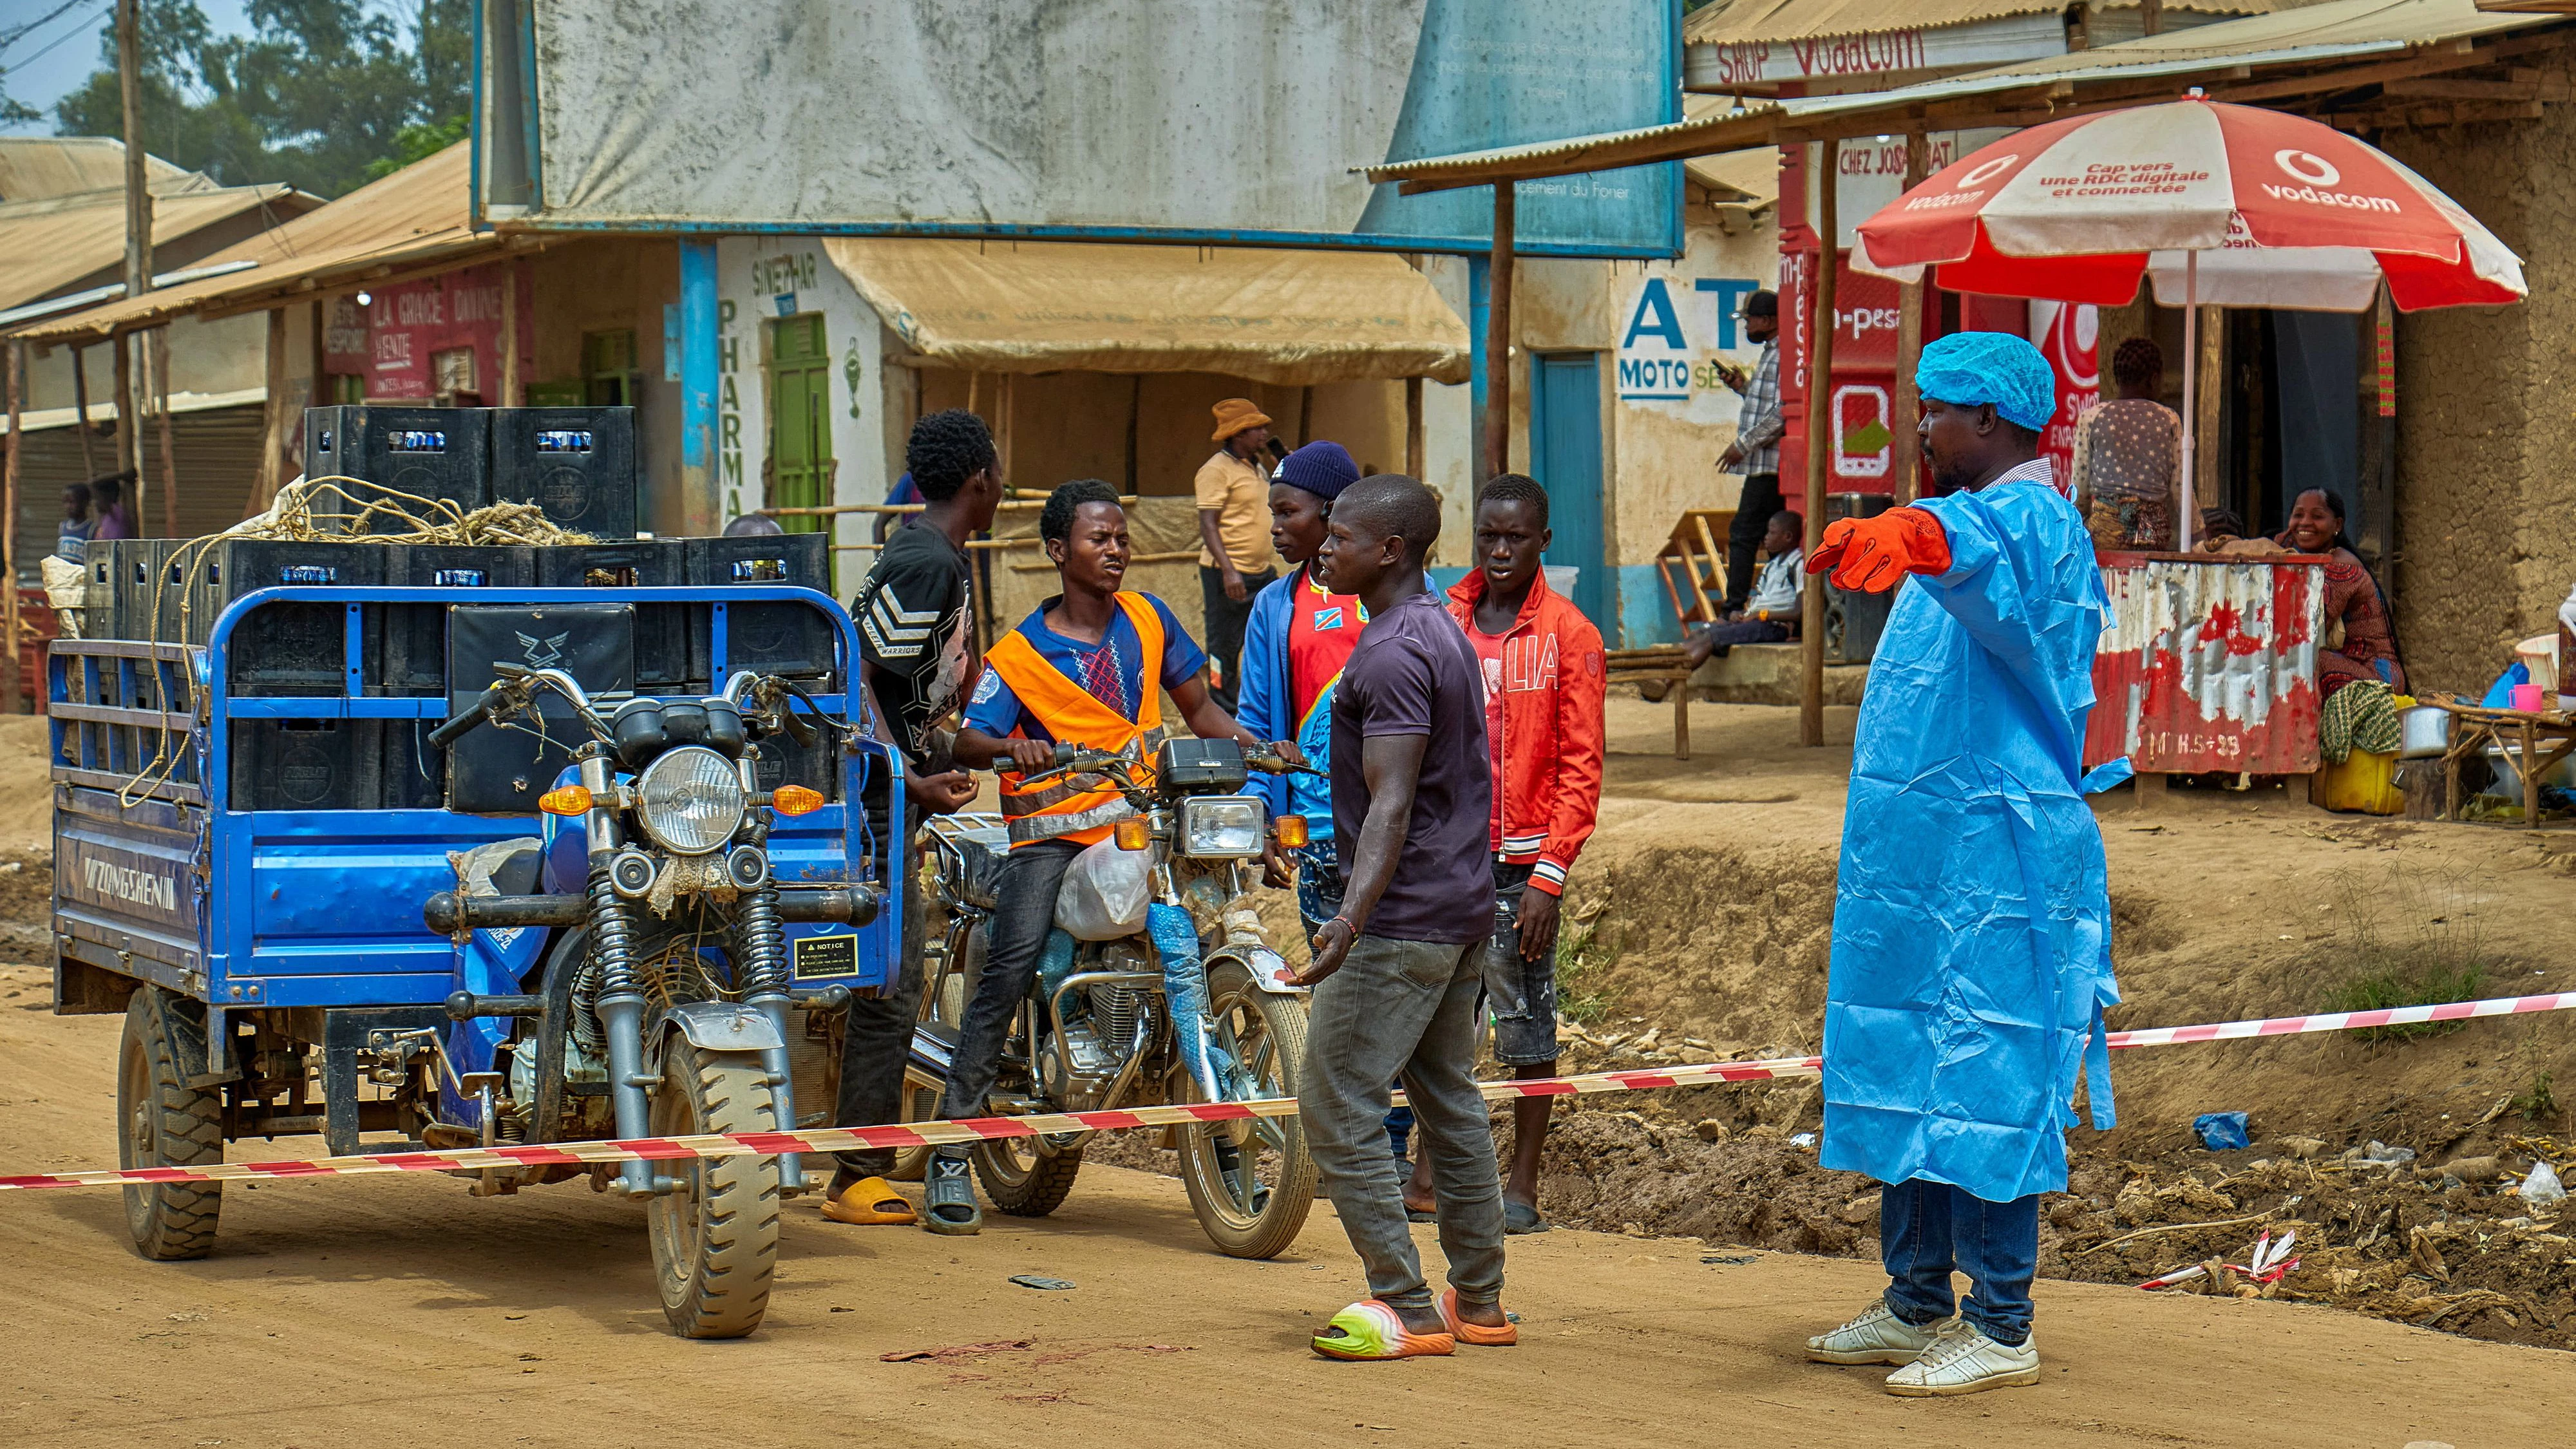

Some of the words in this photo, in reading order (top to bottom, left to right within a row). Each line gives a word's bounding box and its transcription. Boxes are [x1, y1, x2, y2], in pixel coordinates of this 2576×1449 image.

[1718, 39, 1768, 84] SHOP
[1839, 147, 1871, 175] CHEZ
[2087, 163, 2126, 175] Cap
[2130, 162, 2175, 172] vers
[2040, 176, 2079, 185] une
[2083, 173, 2128, 185] RDC
[2130, 170, 2210, 185] digitale
[2052, 187, 2075, 197] et
[2077, 182, 2187, 196] connectée
[1904, 189, 1985, 212] vodacom
[2261, 182, 2402, 214] vodacom
[1620, 358, 1689, 388] MOTO
[882, 647, 920, 655] WARRIORS
[1506, 632, 1559, 693] LIA
